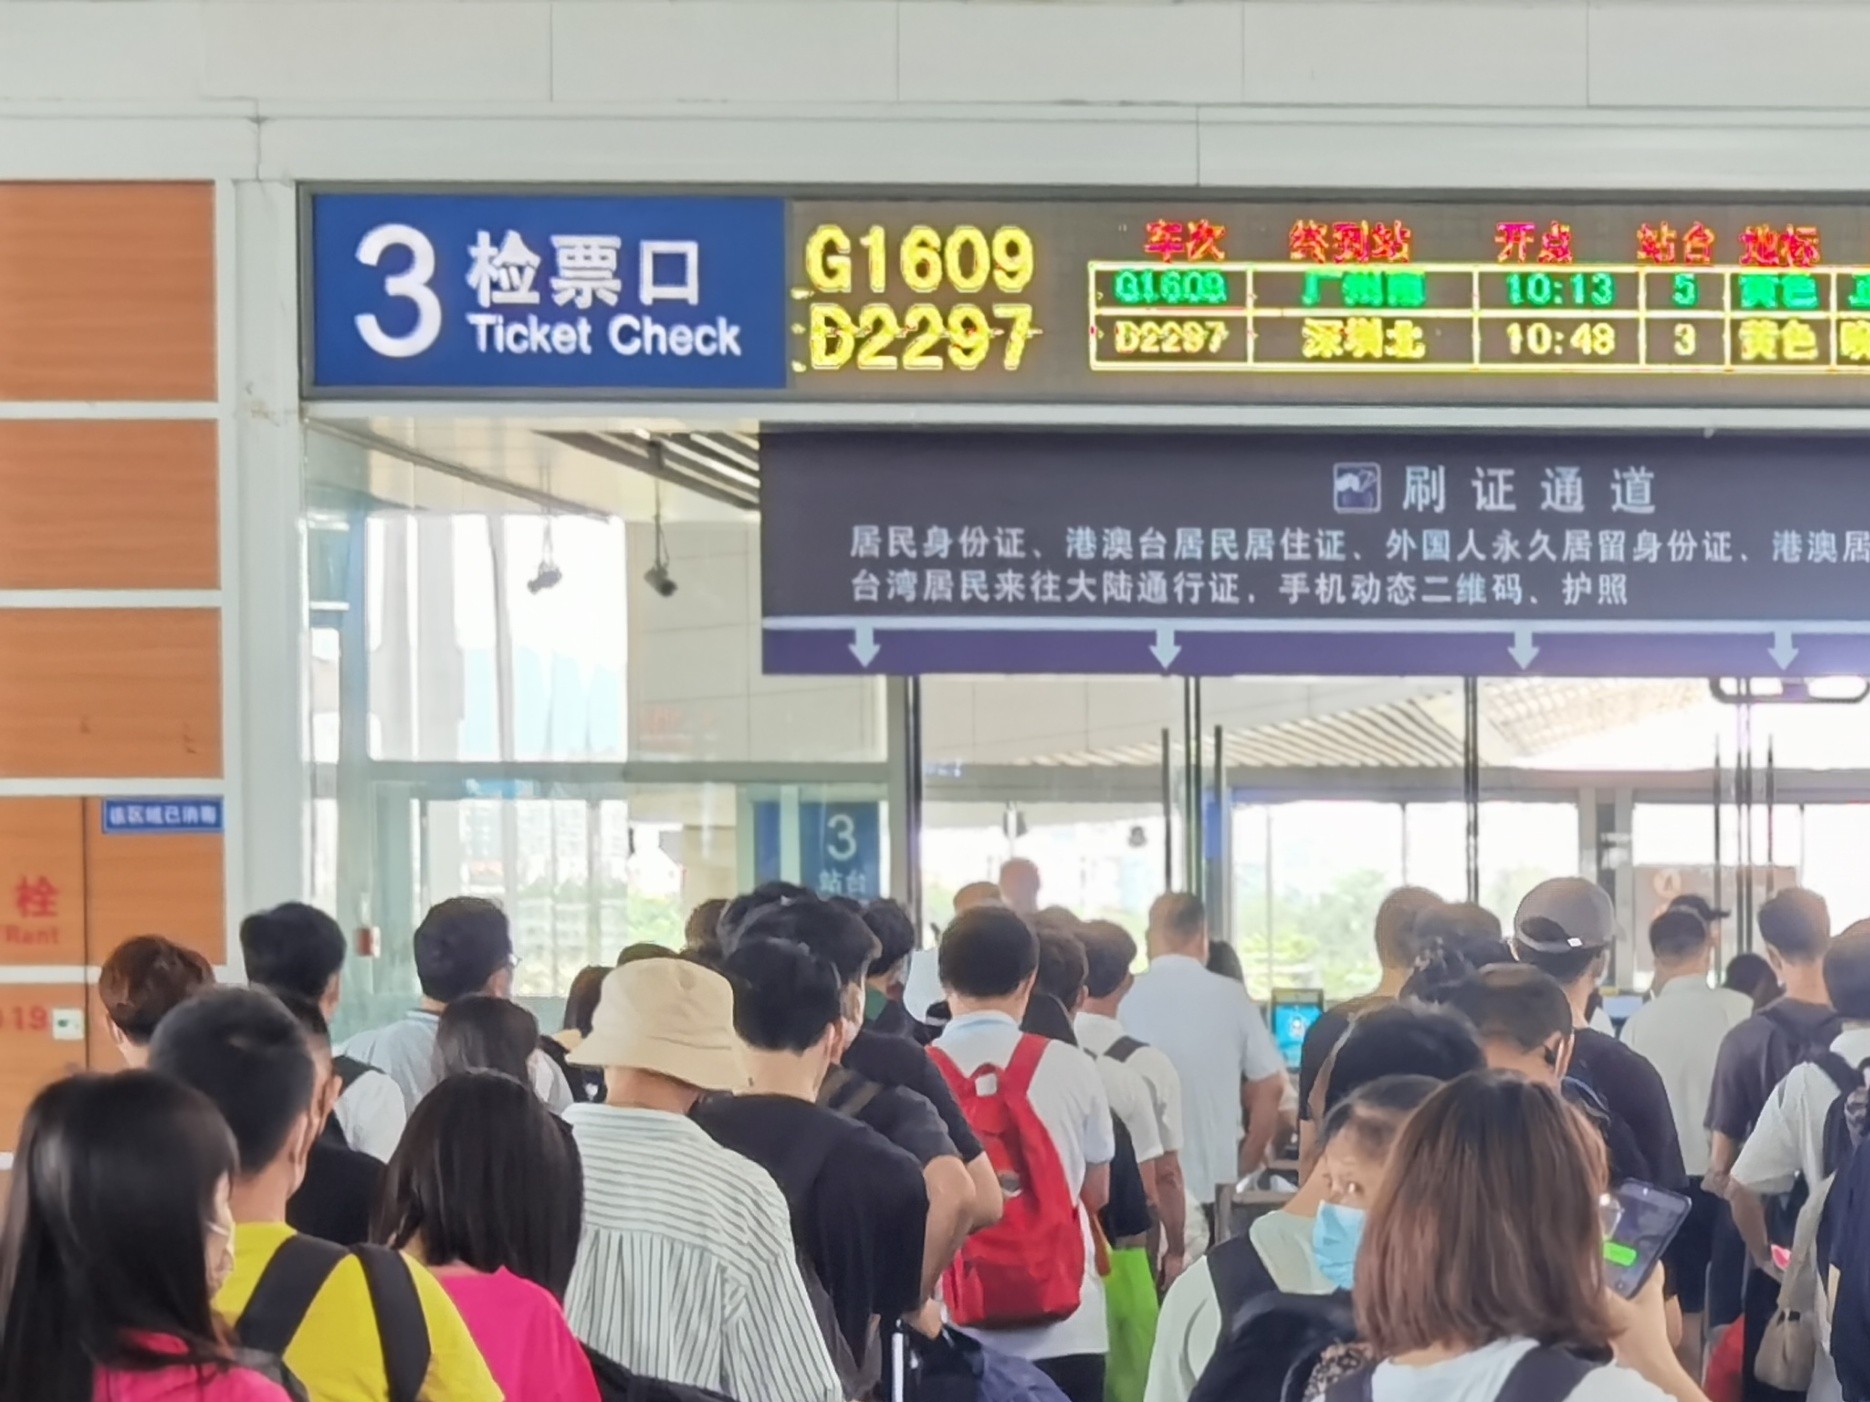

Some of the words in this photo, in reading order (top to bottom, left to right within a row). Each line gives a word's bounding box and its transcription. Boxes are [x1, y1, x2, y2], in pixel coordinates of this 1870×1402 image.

[804, 224, 1034, 294] G1609
[1145, 219, 1226, 262] 车次
[1289, 219, 1411, 262] 终到站
[1495, 221, 1574, 264] 开点
[1637, 221, 1715, 264] 站台
[1739, 223, 1820, 267] 地标
[354, 223, 442, 357] 3
[467, 230, 700, 307] 检票口
[1506, 272, 1615, 307] 10:13
[1672, 272, 1696, 307] 5
[1739, 272, 1818, 307] 黄色
[467, 314, 591, 355] Ticket
[609, 314, 741, 356] Check
[809, 305, 1034, 370] D2297
[1506, 322, 1615, 358] 10:48
[1674, 322, 1697, 358] 3
[1739, 322, 1818, 358] 黄色
[1403, 464, 1656, 514] 刷证通道
[827, 814, 857, 862] 3
[16, 874, 59, 917] 栓
[818, 869, 867, 893] 站台
[0, 1005, 49, 1031] 19
